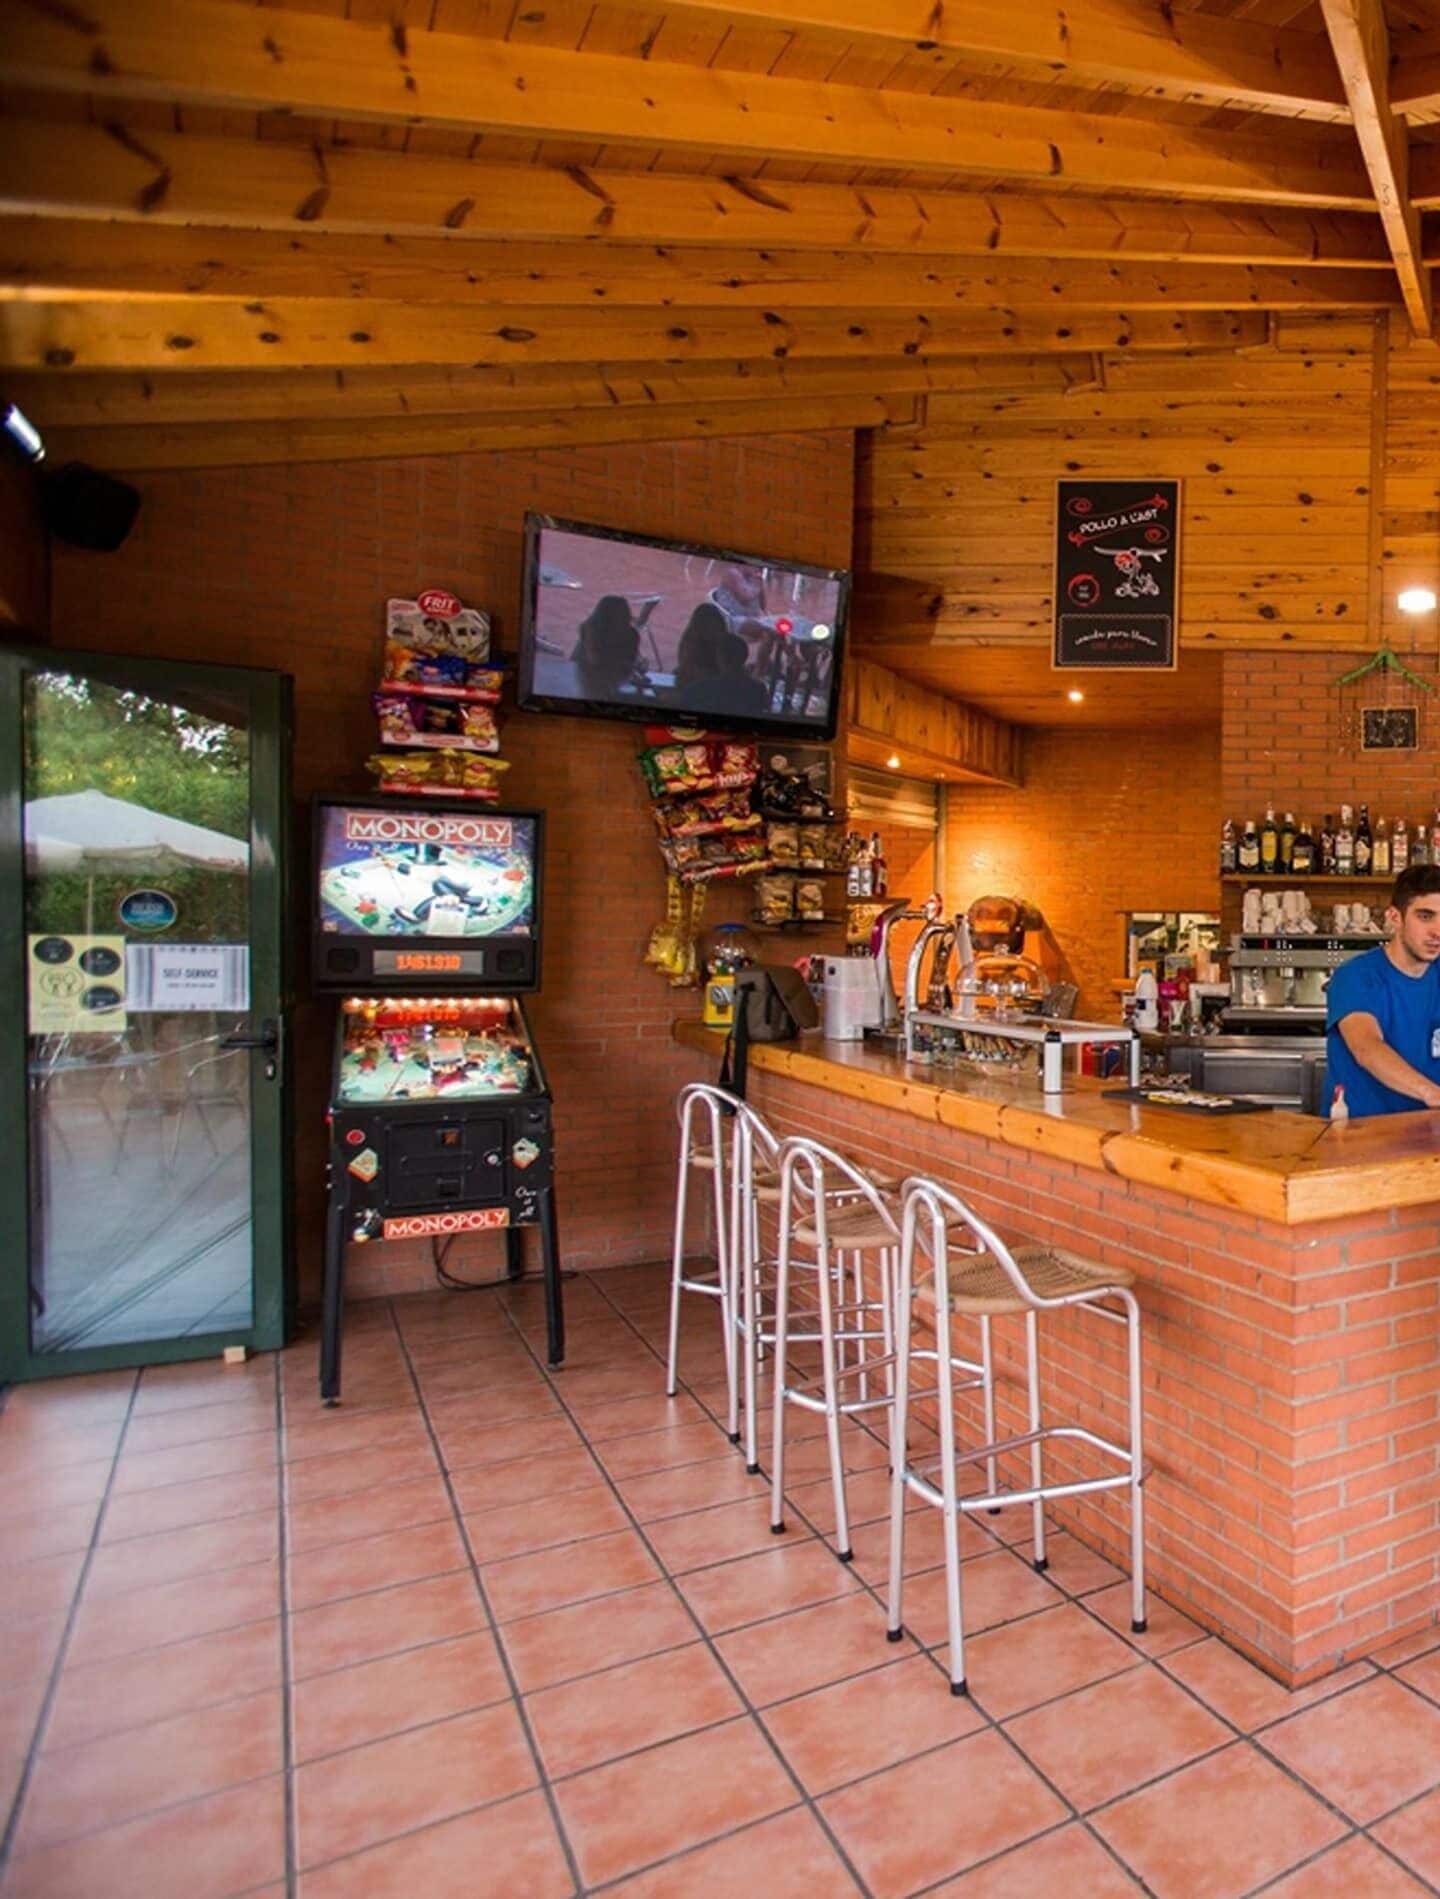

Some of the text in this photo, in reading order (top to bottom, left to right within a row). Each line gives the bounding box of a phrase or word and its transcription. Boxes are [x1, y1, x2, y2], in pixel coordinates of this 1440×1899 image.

[1079, 516, 1118, 534] POLLO
[1120, 514, 1129, 526] A
[423, 596, 455, 610] FRIT
[350, 816, 511, 843] MONOPOLY
[185, 967, 219, 979] SERVICE
[387, 1211, 507, 1237] MONOPOLY
